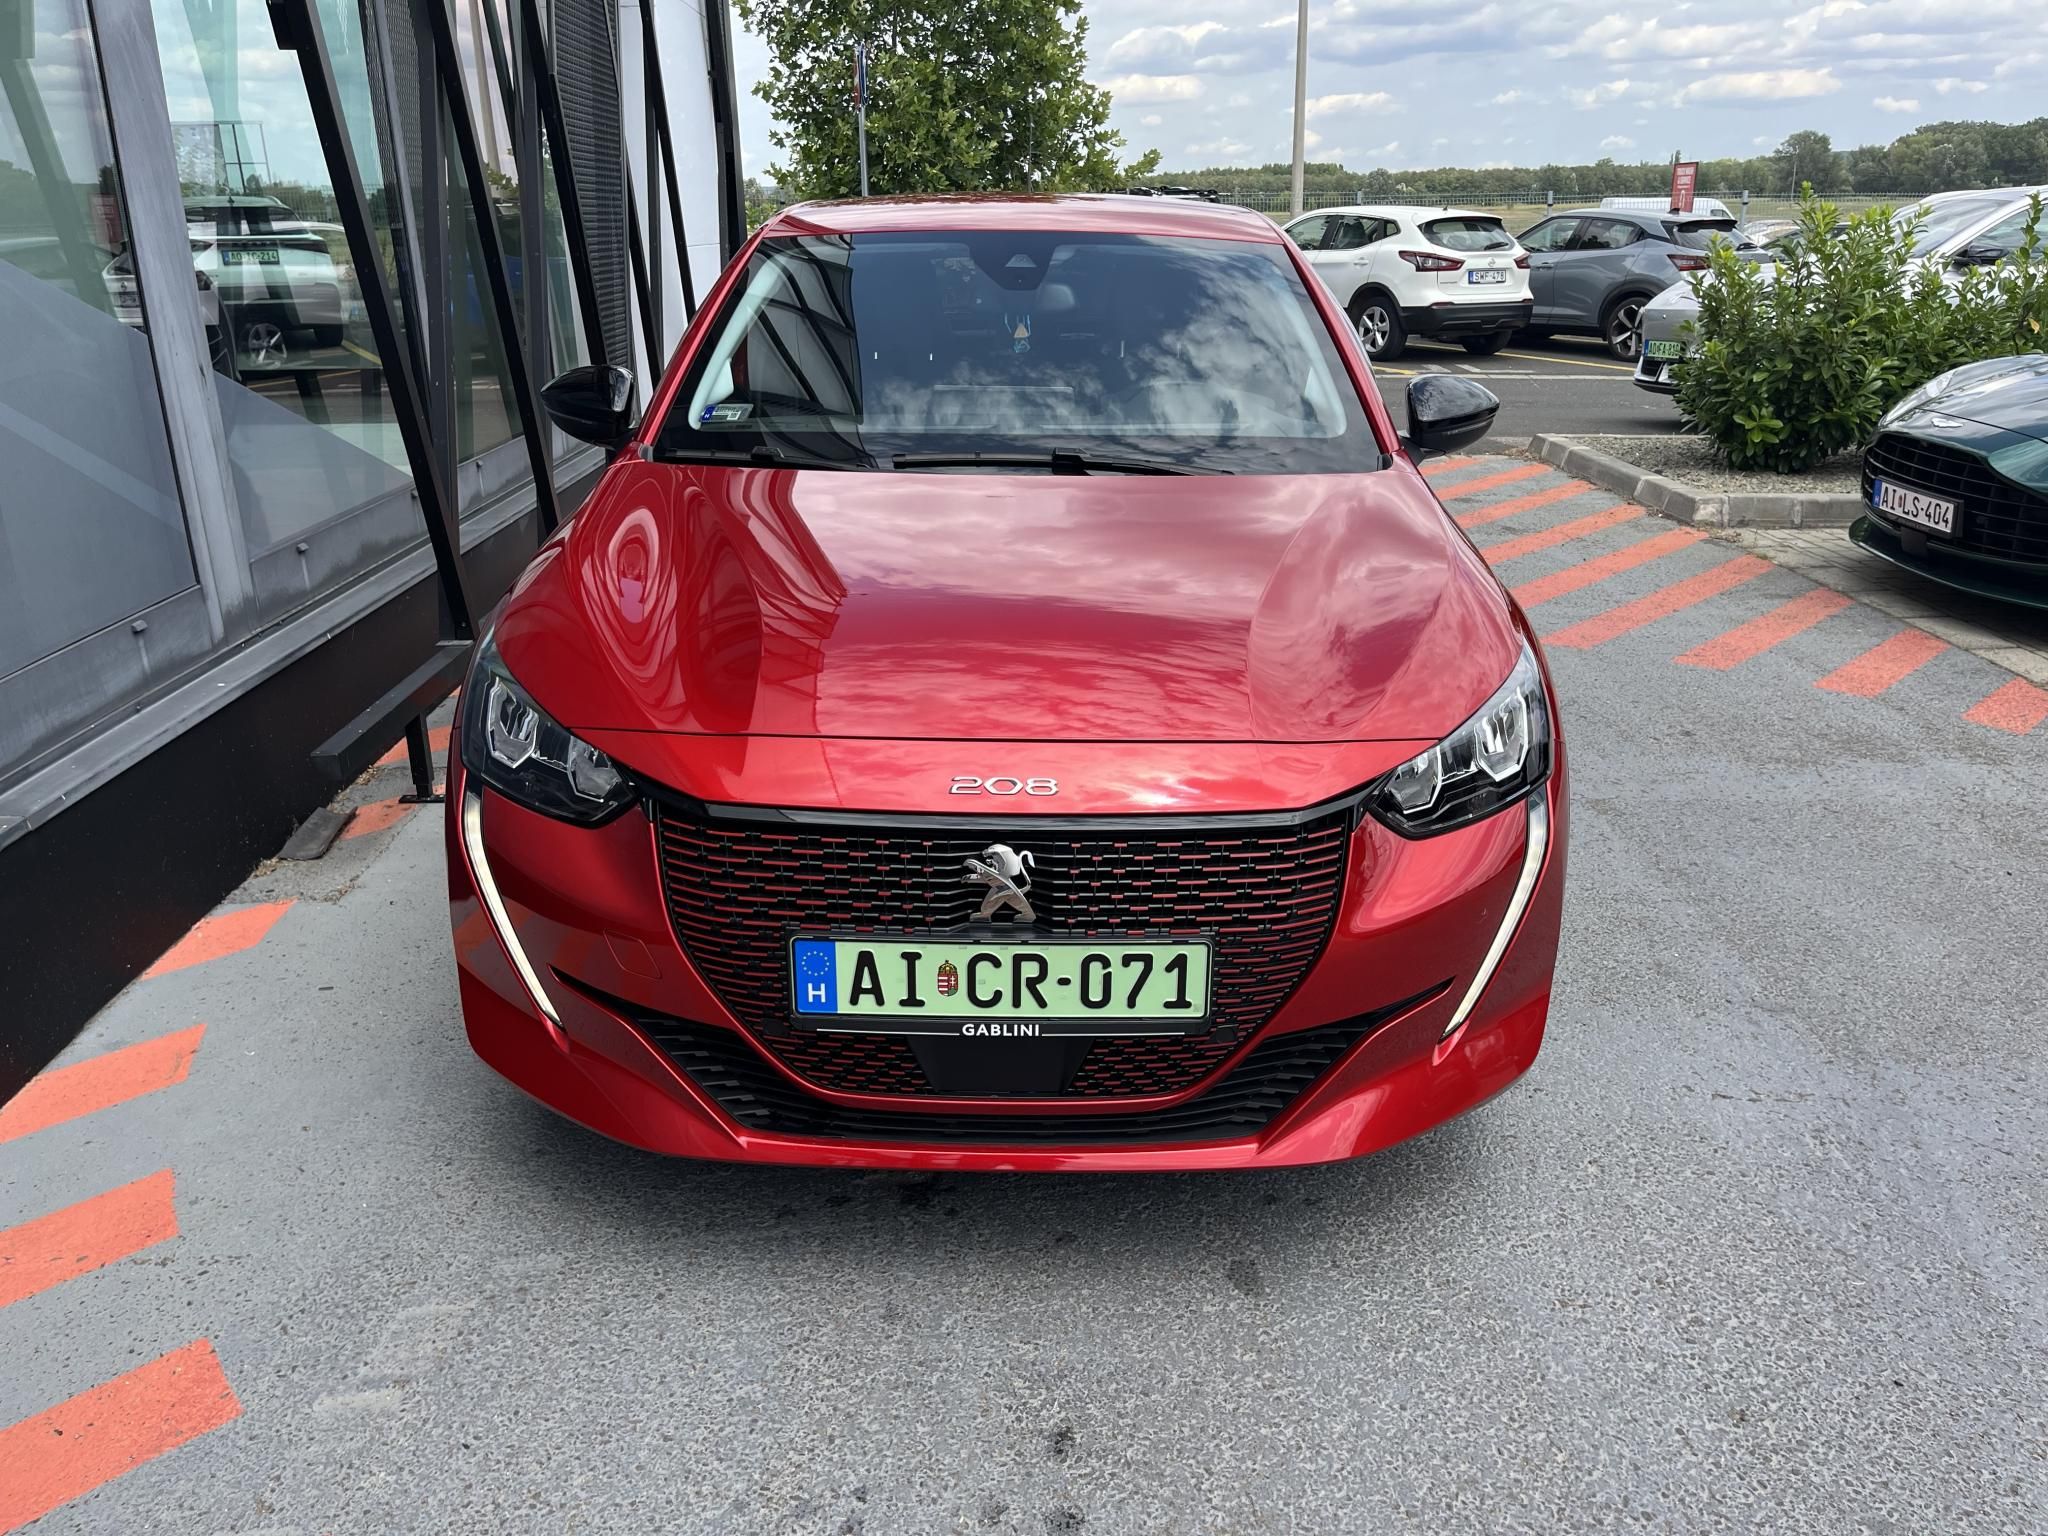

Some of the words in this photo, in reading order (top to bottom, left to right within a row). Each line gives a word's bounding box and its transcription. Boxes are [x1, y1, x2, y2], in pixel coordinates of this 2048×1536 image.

[1881, 485, 1897, 511] AI
[1902, 493, 1950, 529] LS-404
[949, 776, 1059, 796] 208
[808, 963, 826, 1003] H
[849, 950, 926, 1007] AI
[967, 952, 1193, 1009] CR-071
[962, 1024, 1040, 1037] GABLINI
